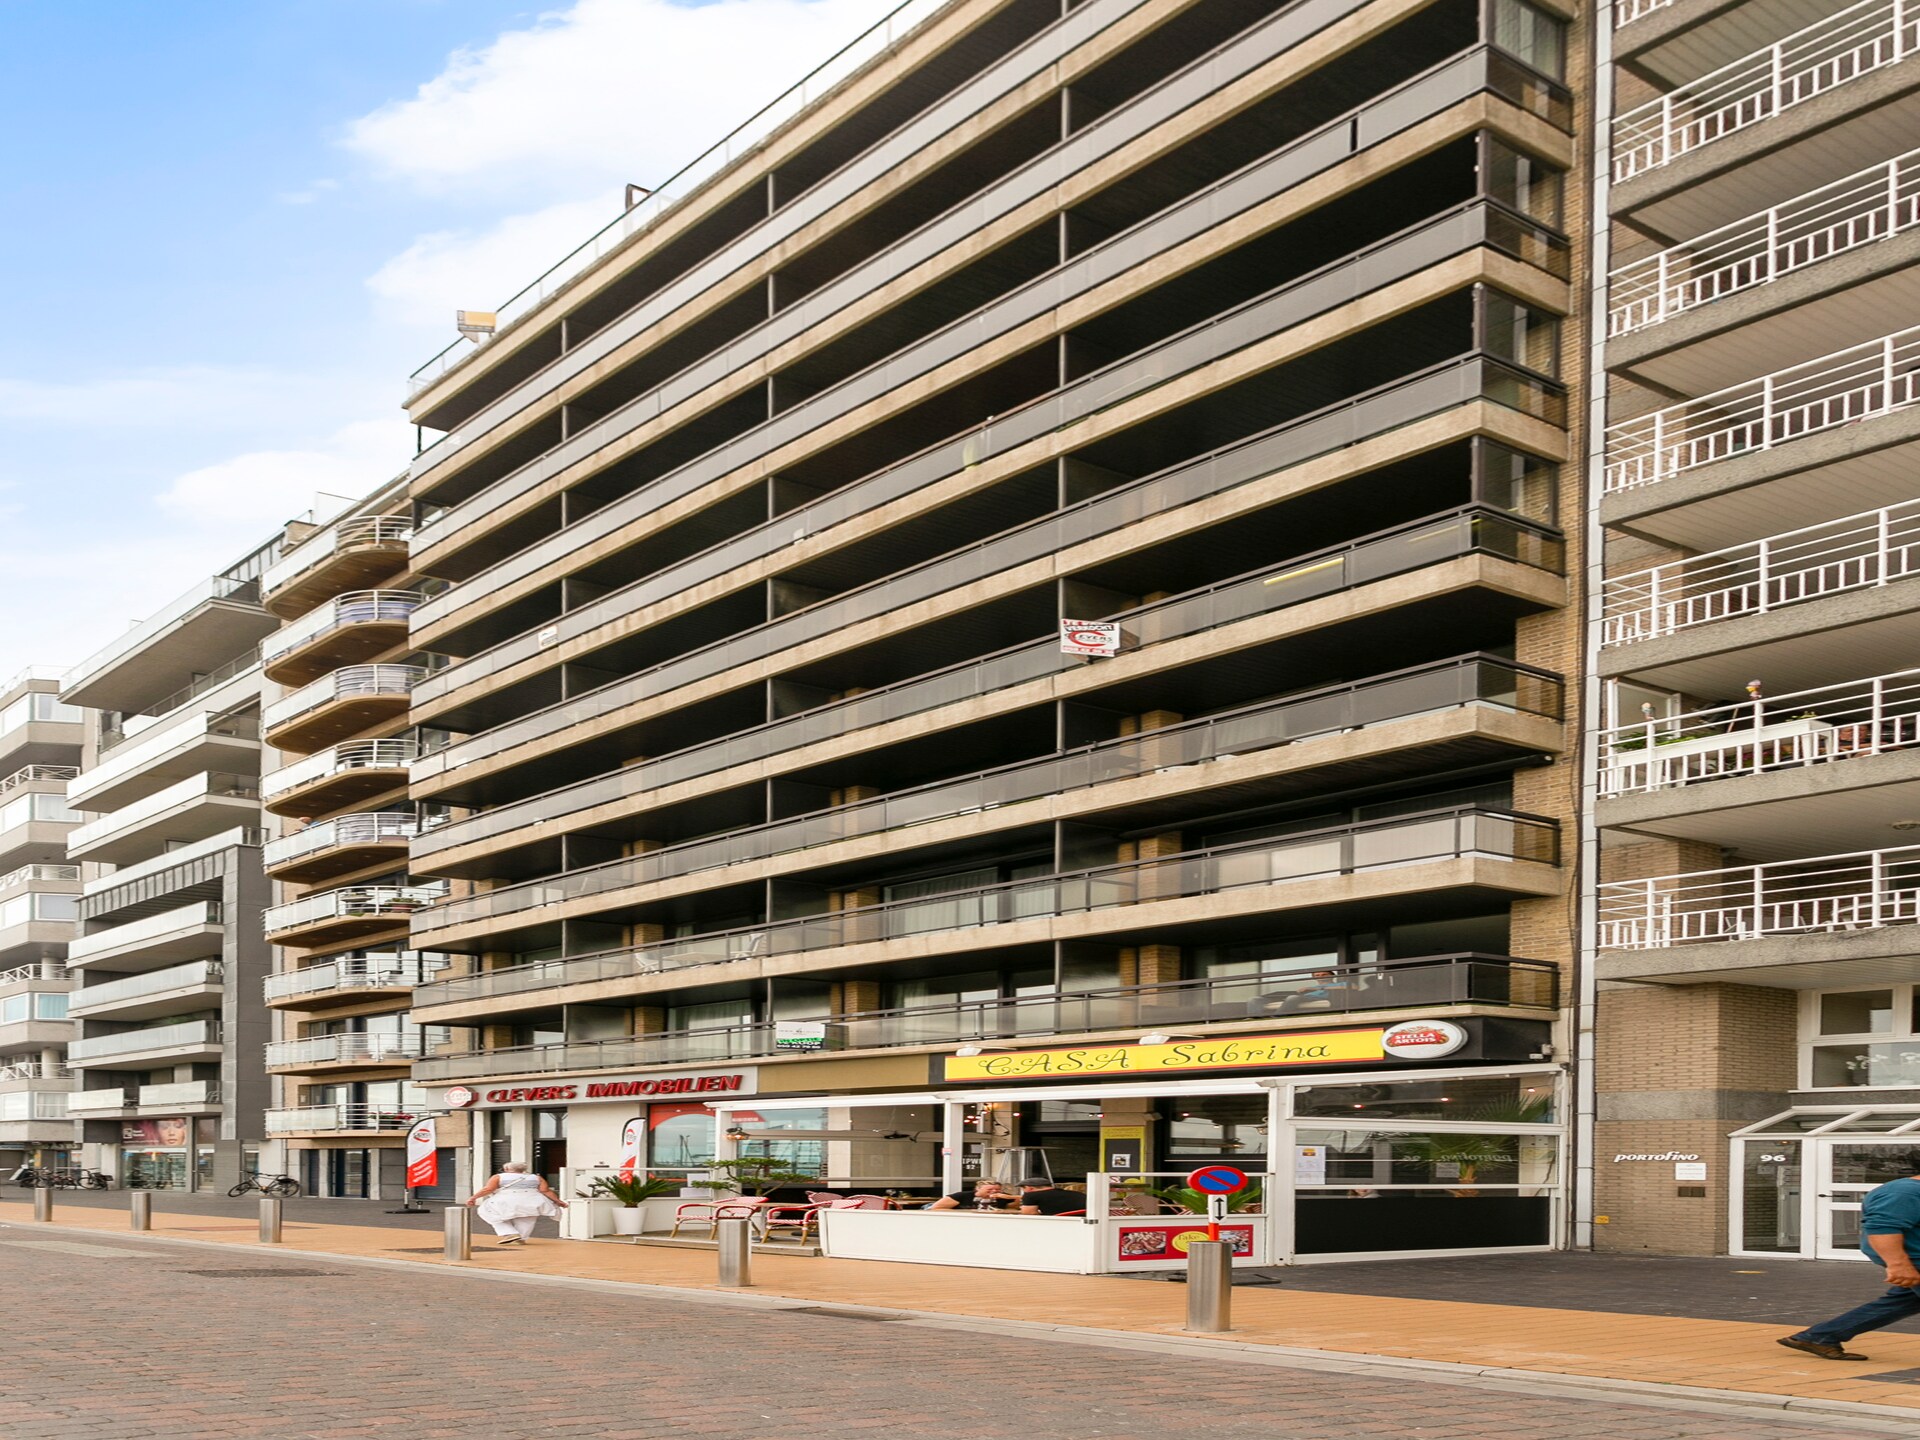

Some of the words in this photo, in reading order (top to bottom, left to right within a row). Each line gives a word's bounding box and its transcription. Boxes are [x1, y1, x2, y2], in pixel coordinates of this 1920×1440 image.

[978, 1049, 1130, 1075] CASA
[1162, 1043, 1331, 1066] Sabrina
[486, 1085, 578, 1103] CLEVERS
[585, 1075, 743, 1098] IMMOBILIEN
[1760, 1154, 1787, 1162] 96
